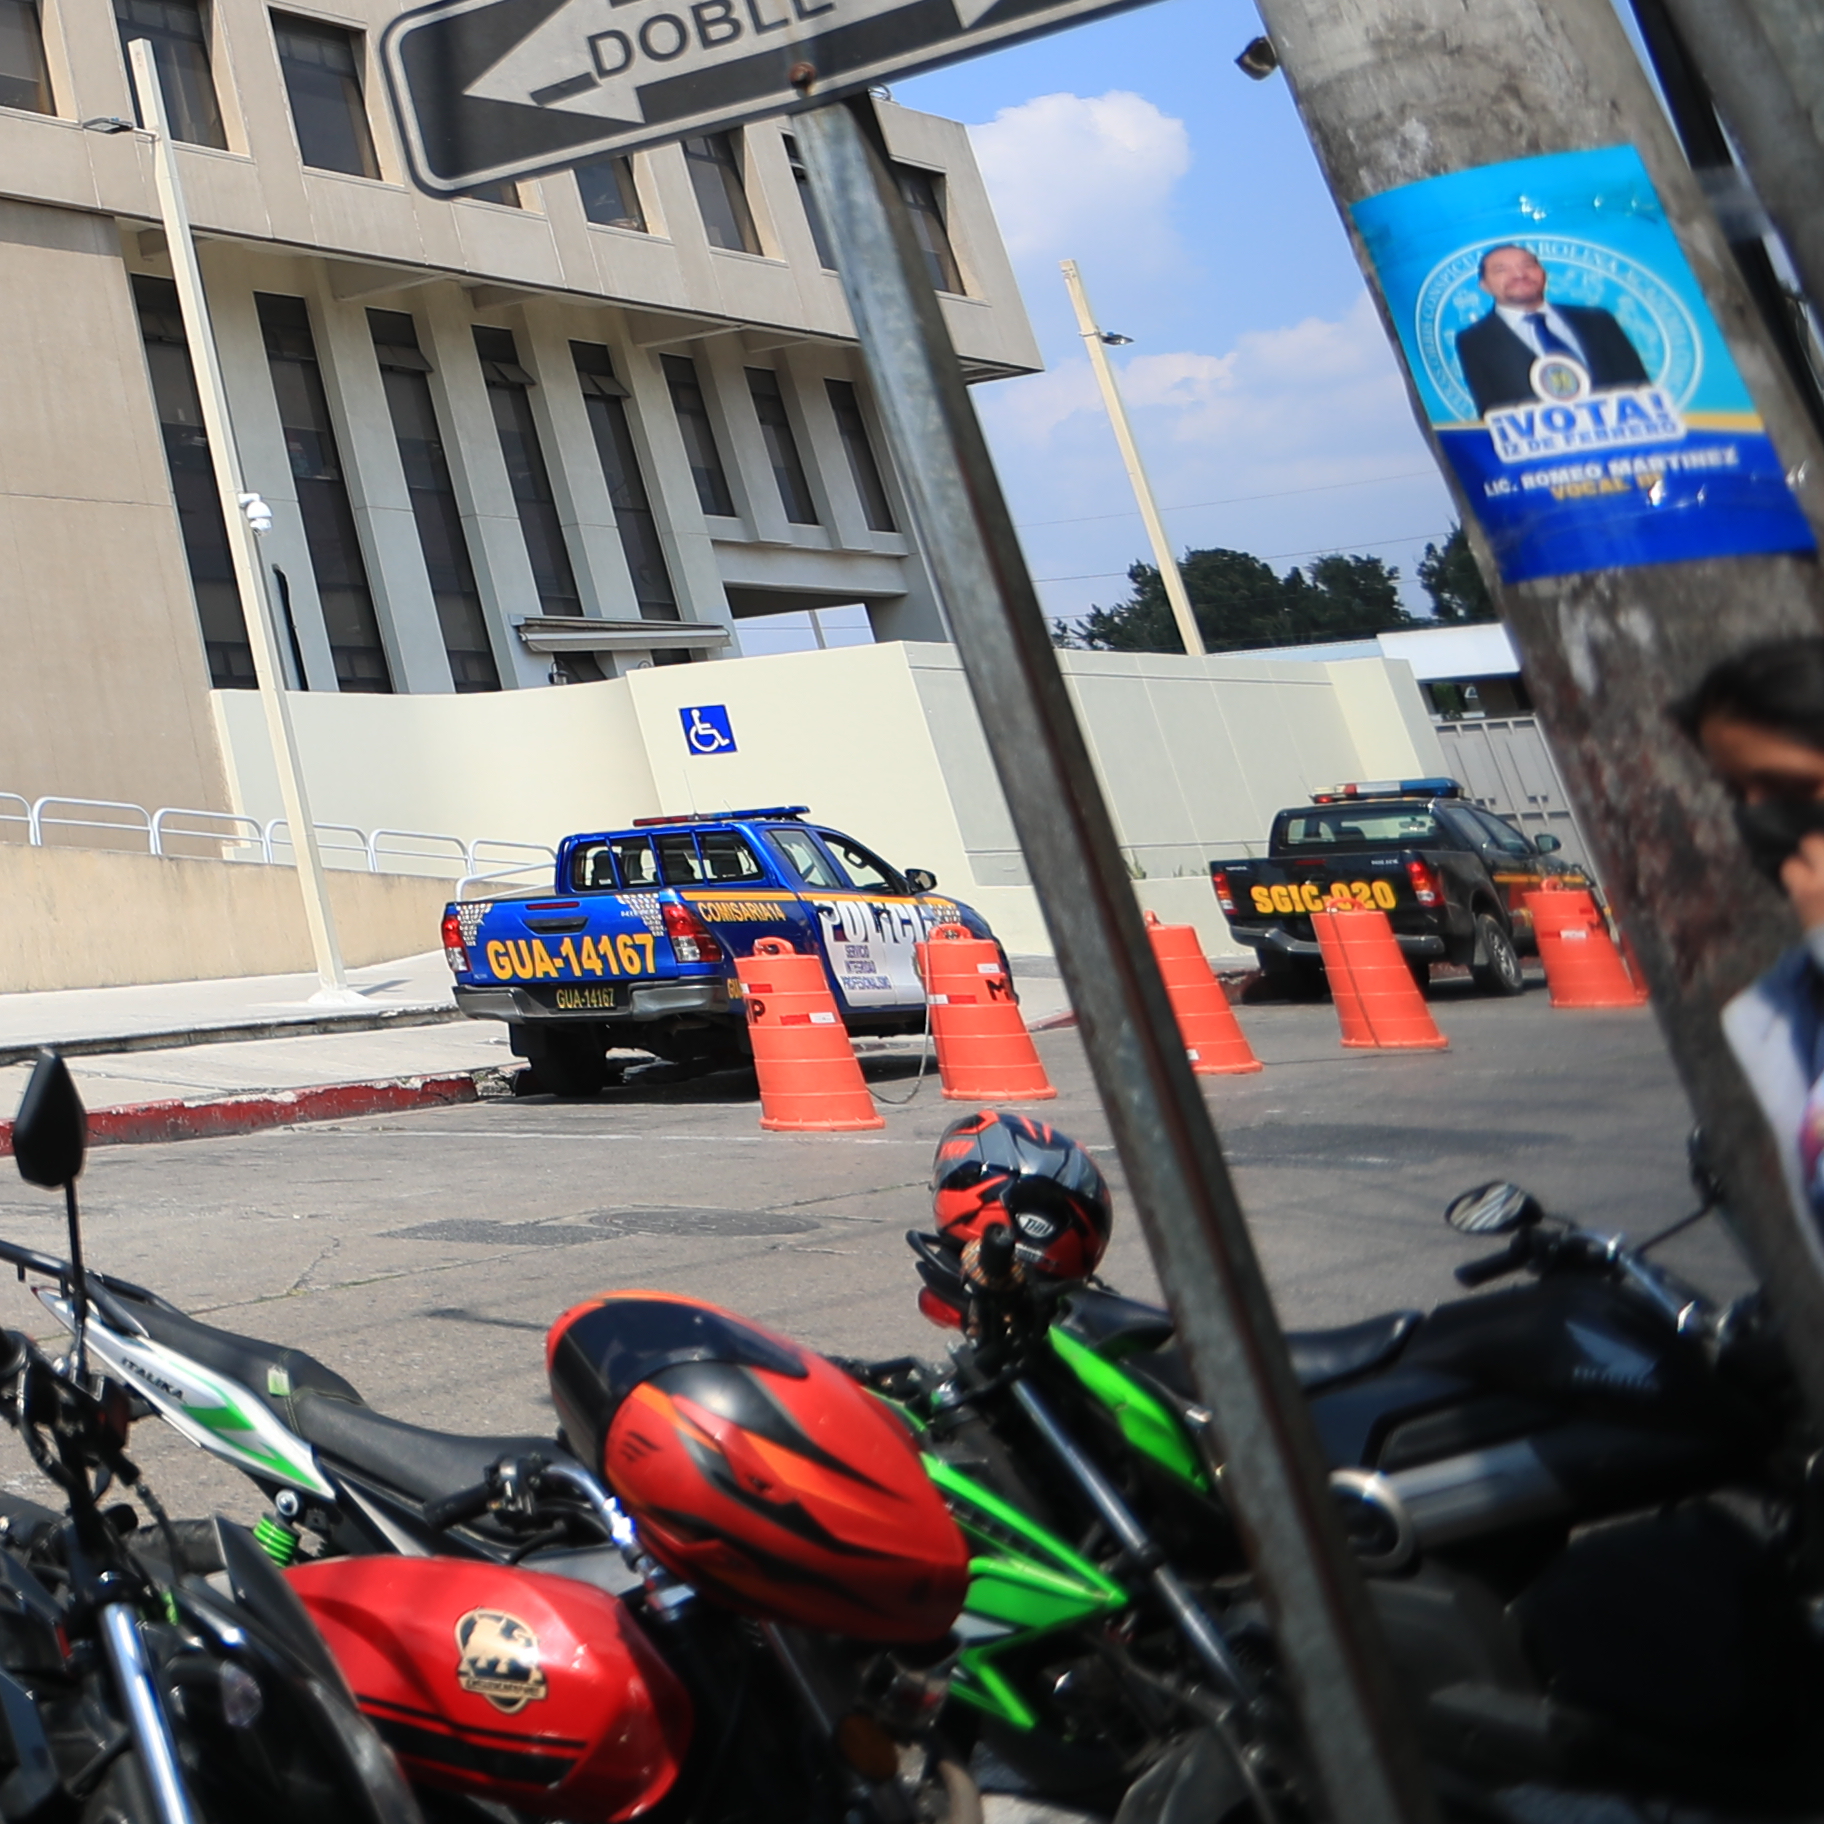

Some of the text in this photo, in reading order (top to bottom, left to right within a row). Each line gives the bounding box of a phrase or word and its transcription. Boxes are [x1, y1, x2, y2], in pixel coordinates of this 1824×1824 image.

[1492, 391, 1670, 442] ¡VOTA!
[1528, 433, 1556, 452] DE
[1483, 479, 1518, 498] LIC.
[1520, 461, 1603, 490] ROMEO
[1548, 477, 1632, 501] VOCAL
[486, 933, 656, 980] GUA-14167
[844, 944, 870, 959] SERVICIO
[555, 988, 615, 1009] GUA-14167
